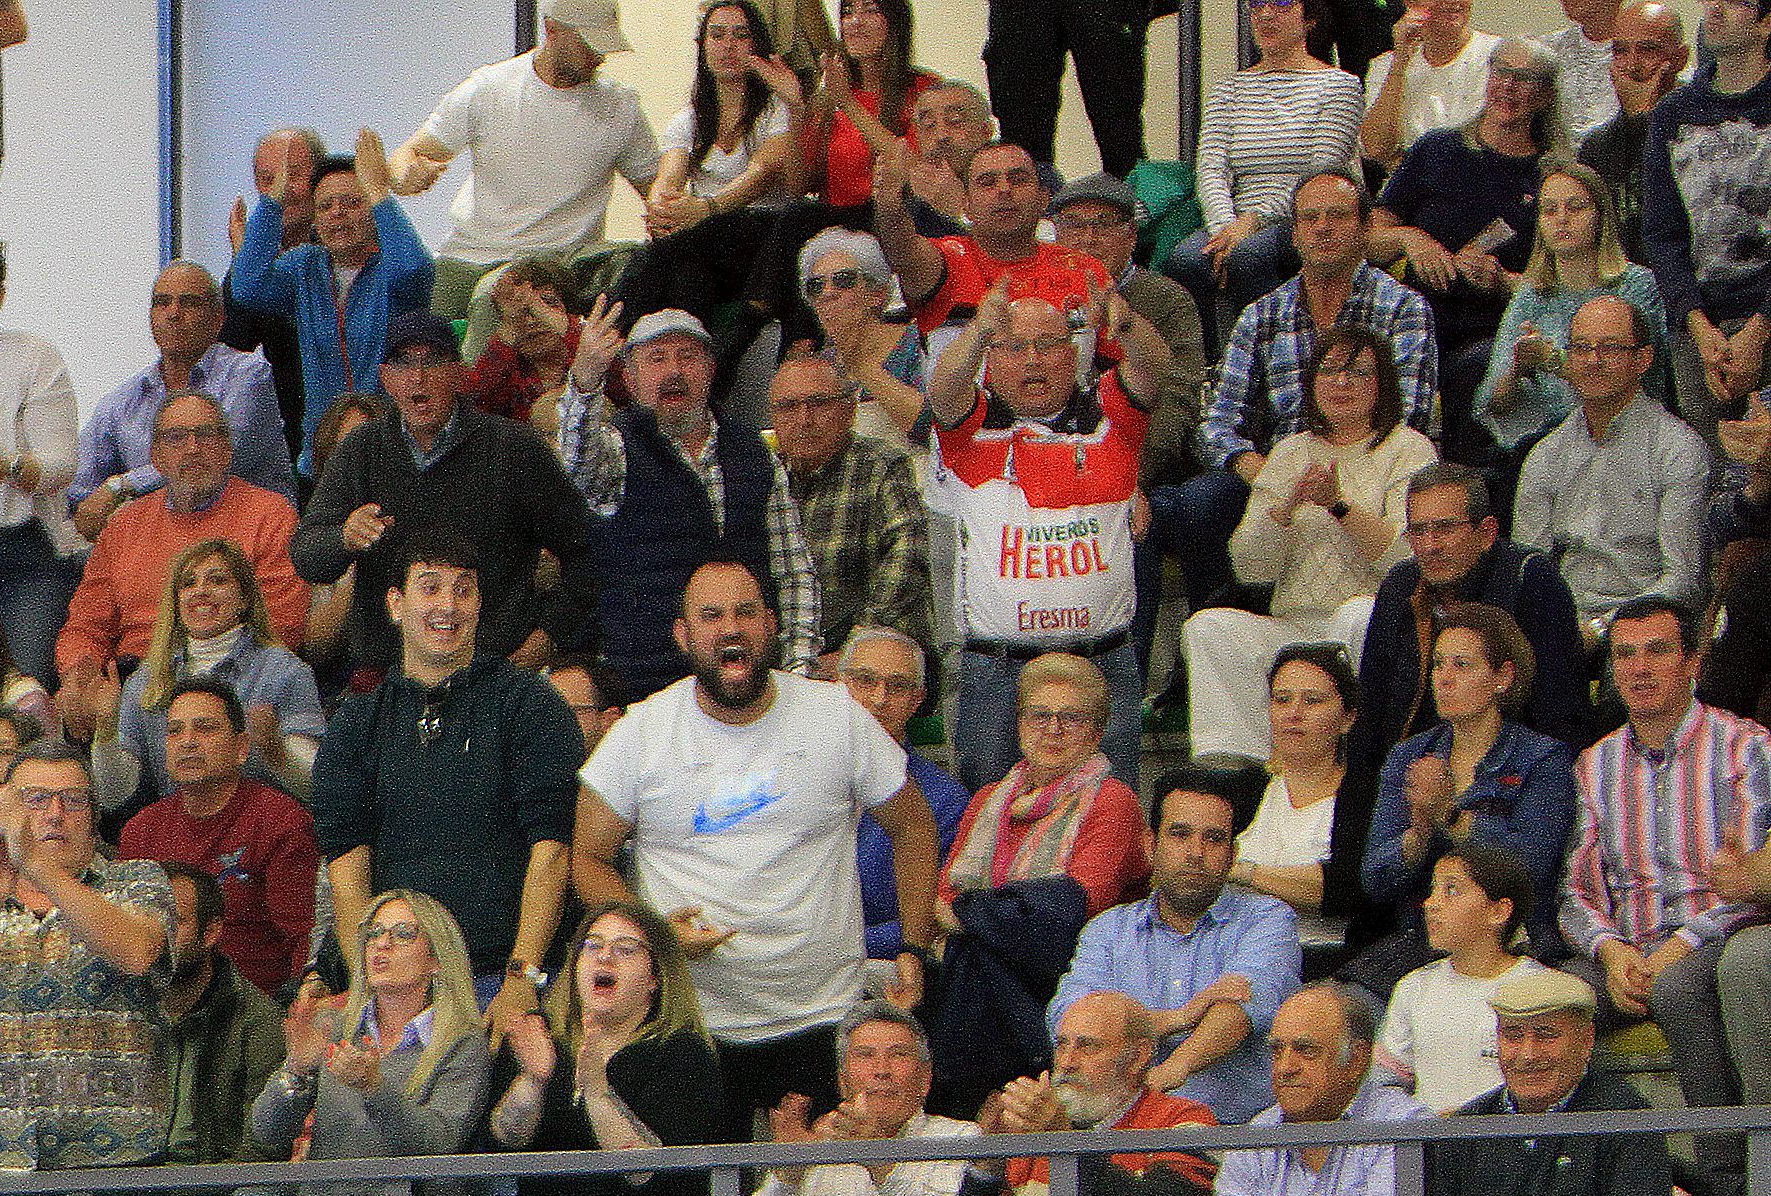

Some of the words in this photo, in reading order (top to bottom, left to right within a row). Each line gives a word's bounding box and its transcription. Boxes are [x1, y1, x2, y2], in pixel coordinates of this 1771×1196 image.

[1025, 517, 1099, 542] VIVEROS
[999, 524, 1110, 580] HEROL
[1017, 600, 1091, 631] Eresma
